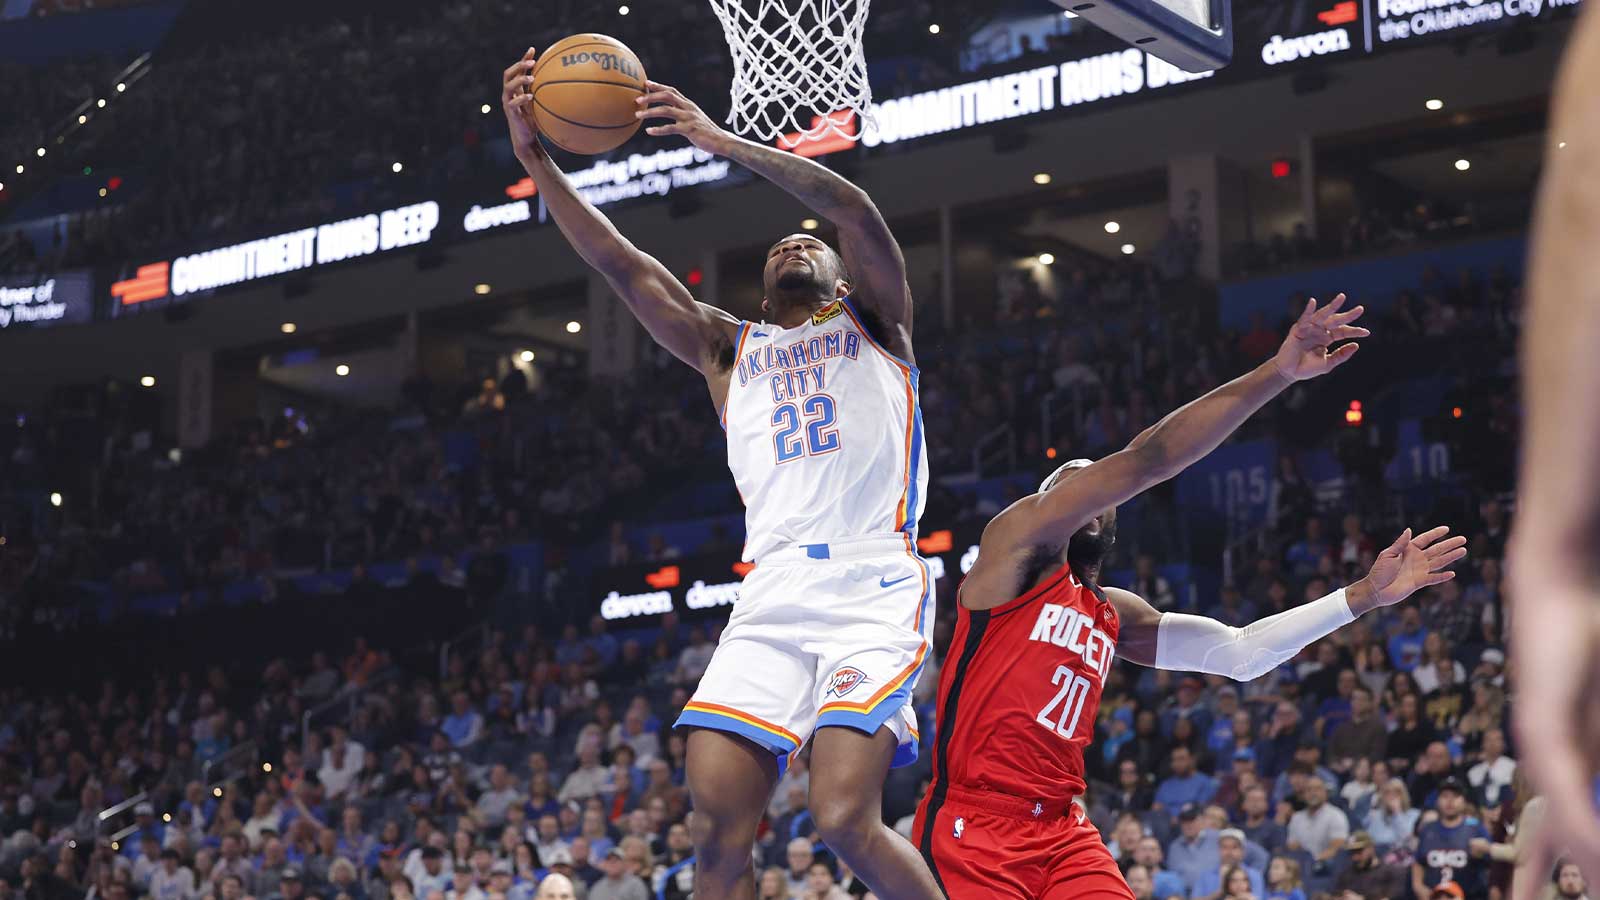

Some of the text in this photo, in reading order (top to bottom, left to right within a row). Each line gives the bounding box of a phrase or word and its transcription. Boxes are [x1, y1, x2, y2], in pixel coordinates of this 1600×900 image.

[1411, 2, 1503, 35] Oklahoma
[561, 51, 639, 81] Wilson
[1262, 28, 1349, 64] devon
[861, 66, 1059, 147] COMMITMENT
[1060, 47, 1144, 106] RUNS
[628, 147, 694, 177] Partner
[464, 201, 530, 232] devon
[171, 200, 440, 296] COMMITMENT RUNS DEEP
[738, 330, 860, 387] OKLAHOMA
[770, 363, 825, 404] CITY
[771, 393, 841, 465] 22
[601, 580, 743, 619] devon devo
[1029, 602, 1115, 689] ROCET
[1036, 665, 1091, 739] 20
